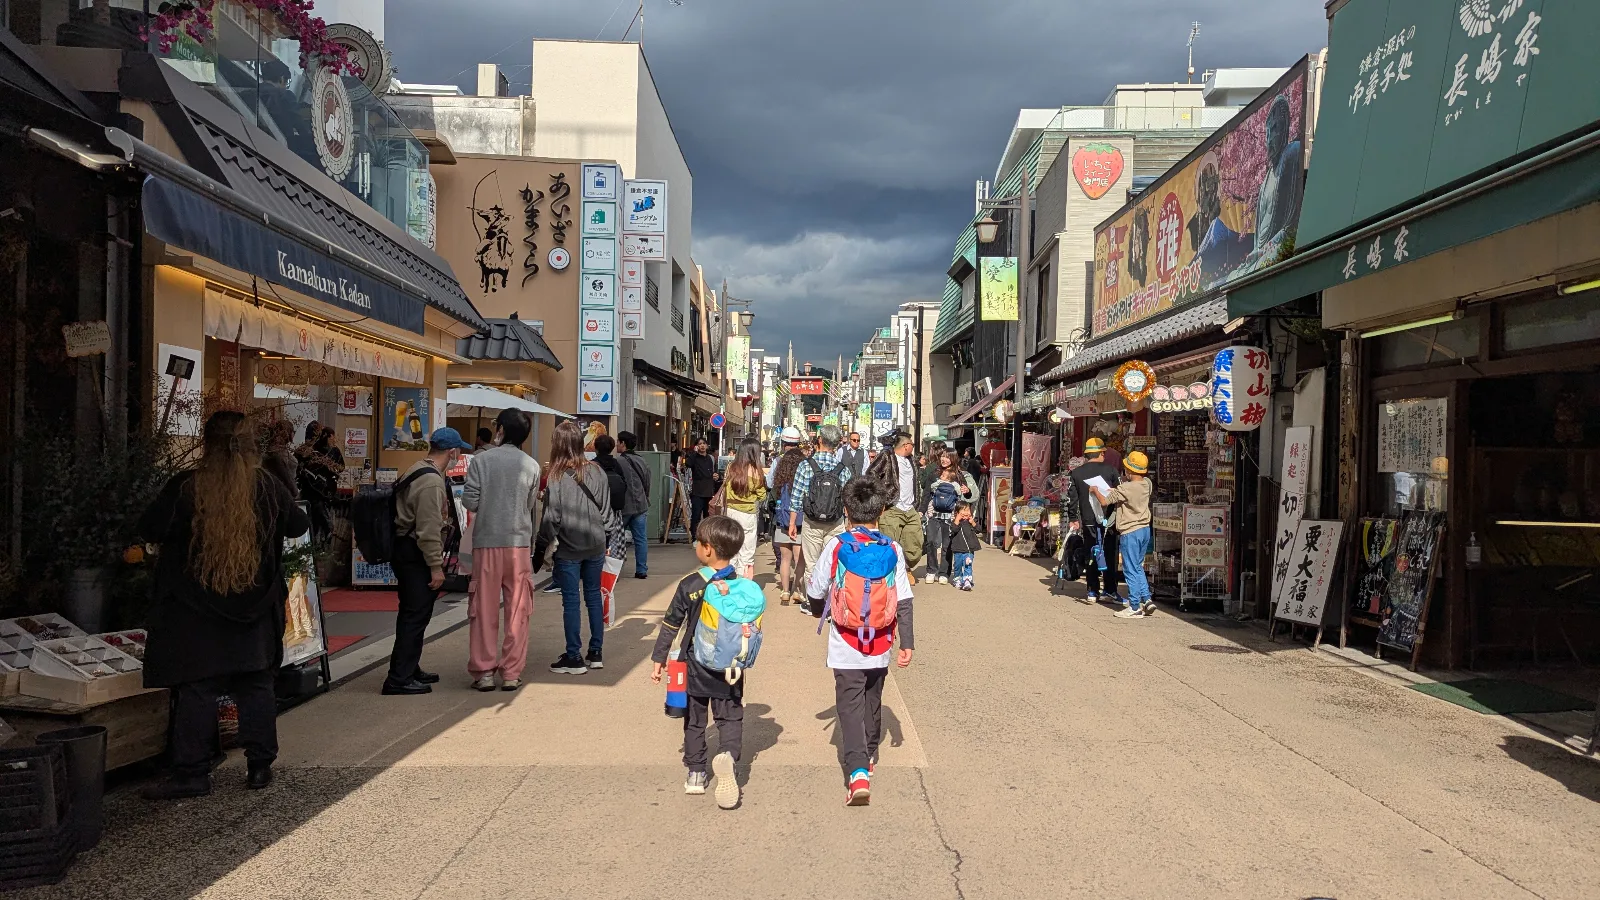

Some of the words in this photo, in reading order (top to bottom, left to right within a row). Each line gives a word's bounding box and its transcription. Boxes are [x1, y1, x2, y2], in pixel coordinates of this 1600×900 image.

[1444, 11, 1542, 107] 長嶋家
[1083, 159, 1113, 171] いちご
[519, 182, 545, 288] かまくら
[1157, 213, 1180, 276] 雅
[1342, 225, 1409, 280] 長嶋家
[277, 249, 338, 298] Kamakura
[338, 277, 372, 309] Kadan
[1152, 382, 1213, 400] おみや
[1152, 398, 1213, 412] SOUVEN
[1281, 600, 1319, 619] 長嶋家
